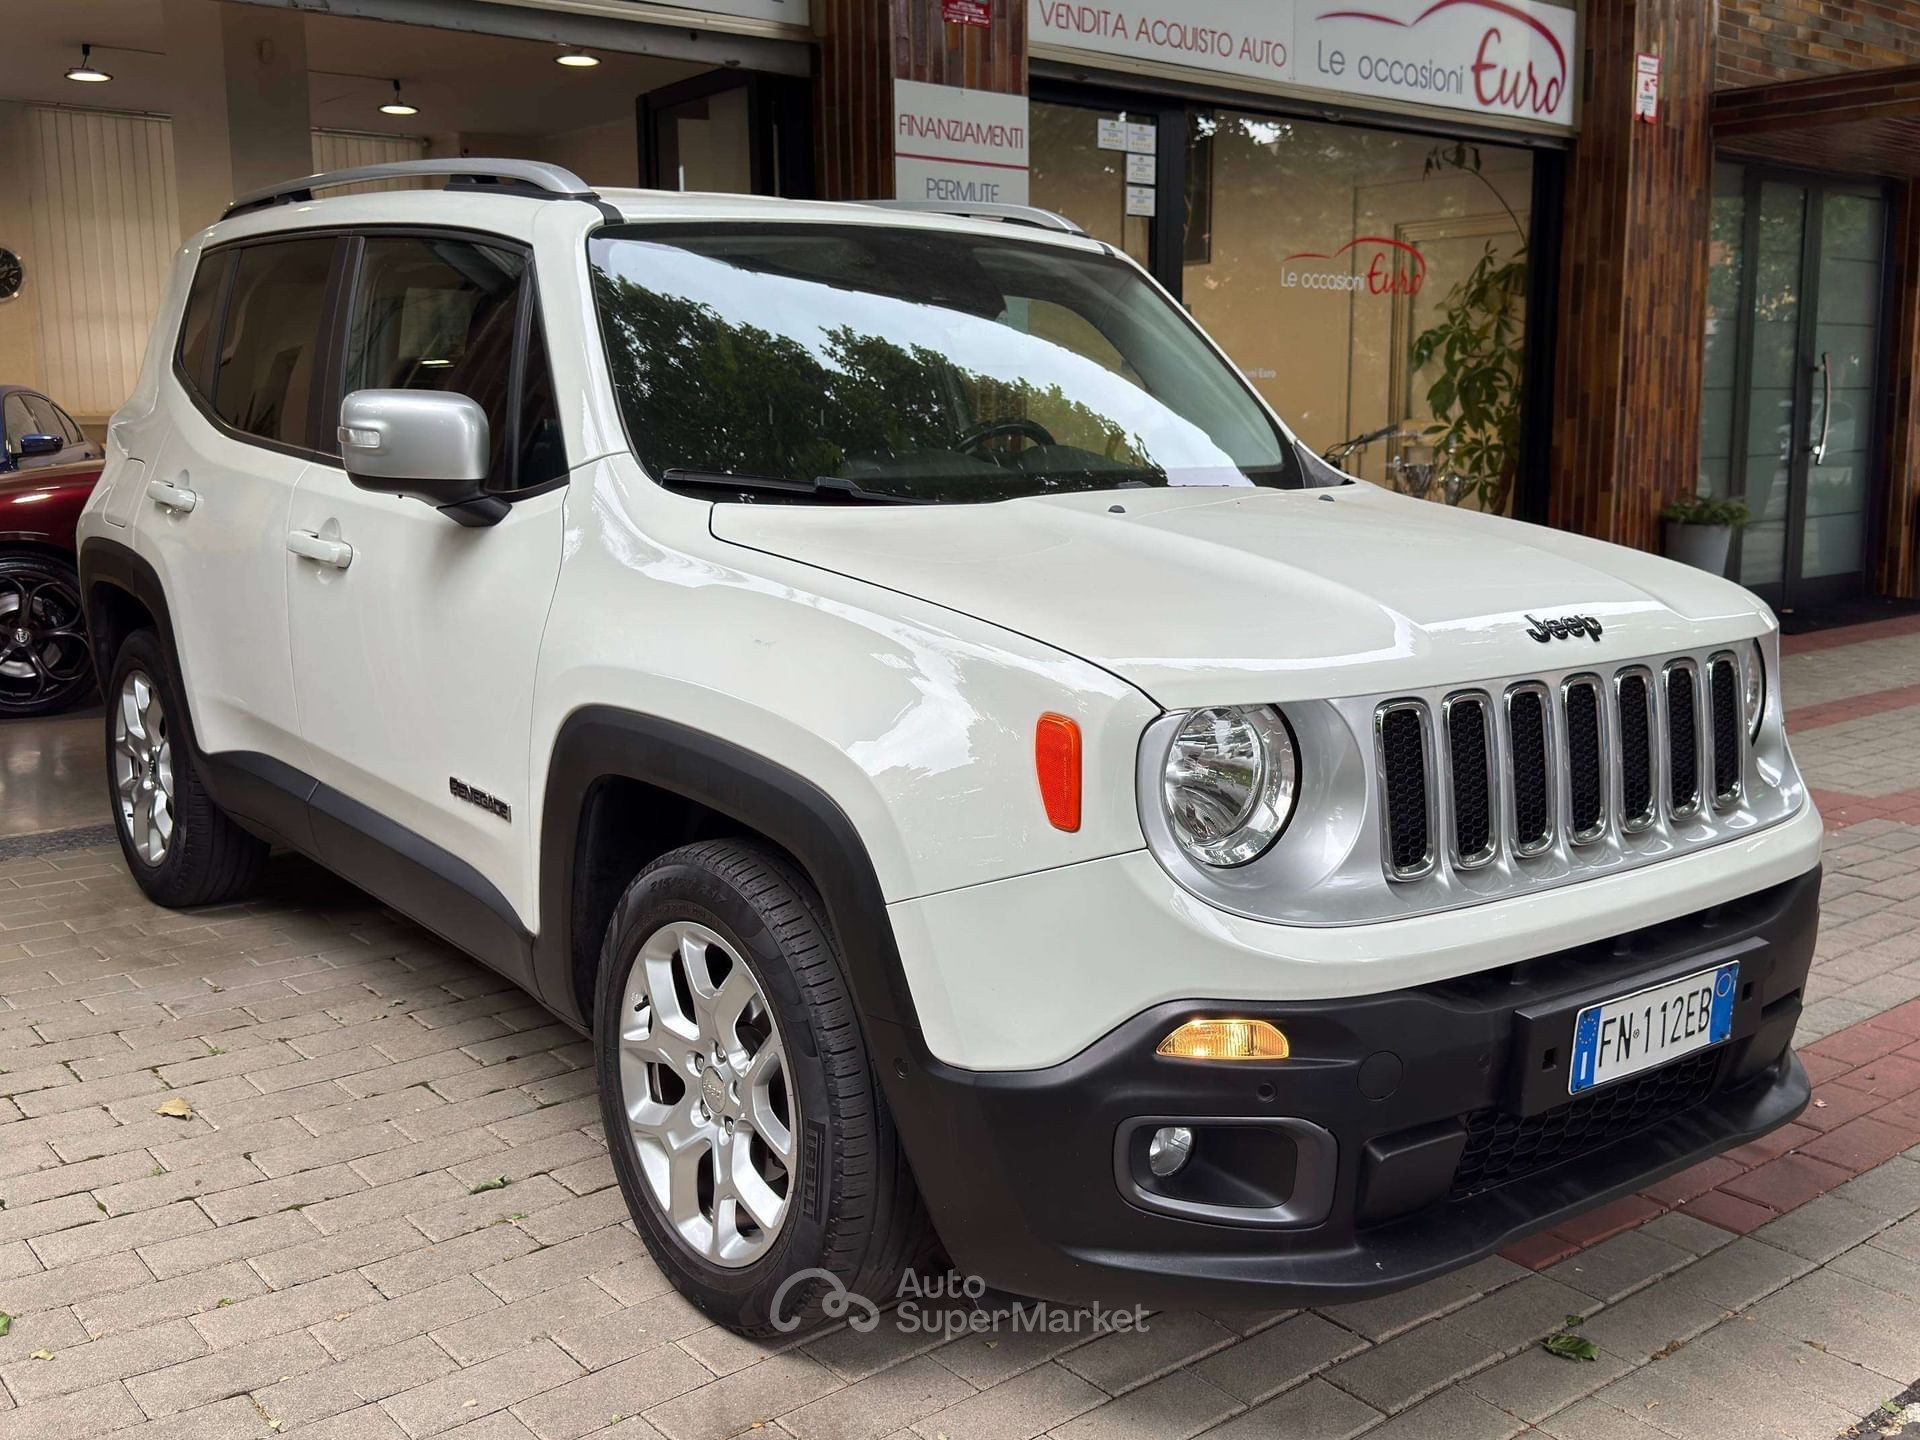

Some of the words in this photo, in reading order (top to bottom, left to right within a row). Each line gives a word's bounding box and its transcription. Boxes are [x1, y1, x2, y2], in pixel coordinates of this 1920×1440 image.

[1039, 0, 1128, 40] VENDITA
[1136, 17, 1233, 57] ACQUISTO
[1238, 37, 1288, 67] AUTO
[1318, 39, 1345, 75] Le
[1358, 55, 1463, 94] occasioni
[1471, 27, 1562, 114] Euro
[899, 113, 1024, 149] FINANZIAMENTI
[1280, 266, 1298, 287] Le
[1301, 271, 1365, 291] occasioni
[1366, 252, 1423, 295] Euro
[1524, 613, 1603, 643] Jeep
[449, 776, 512, 824] RENEGADE
